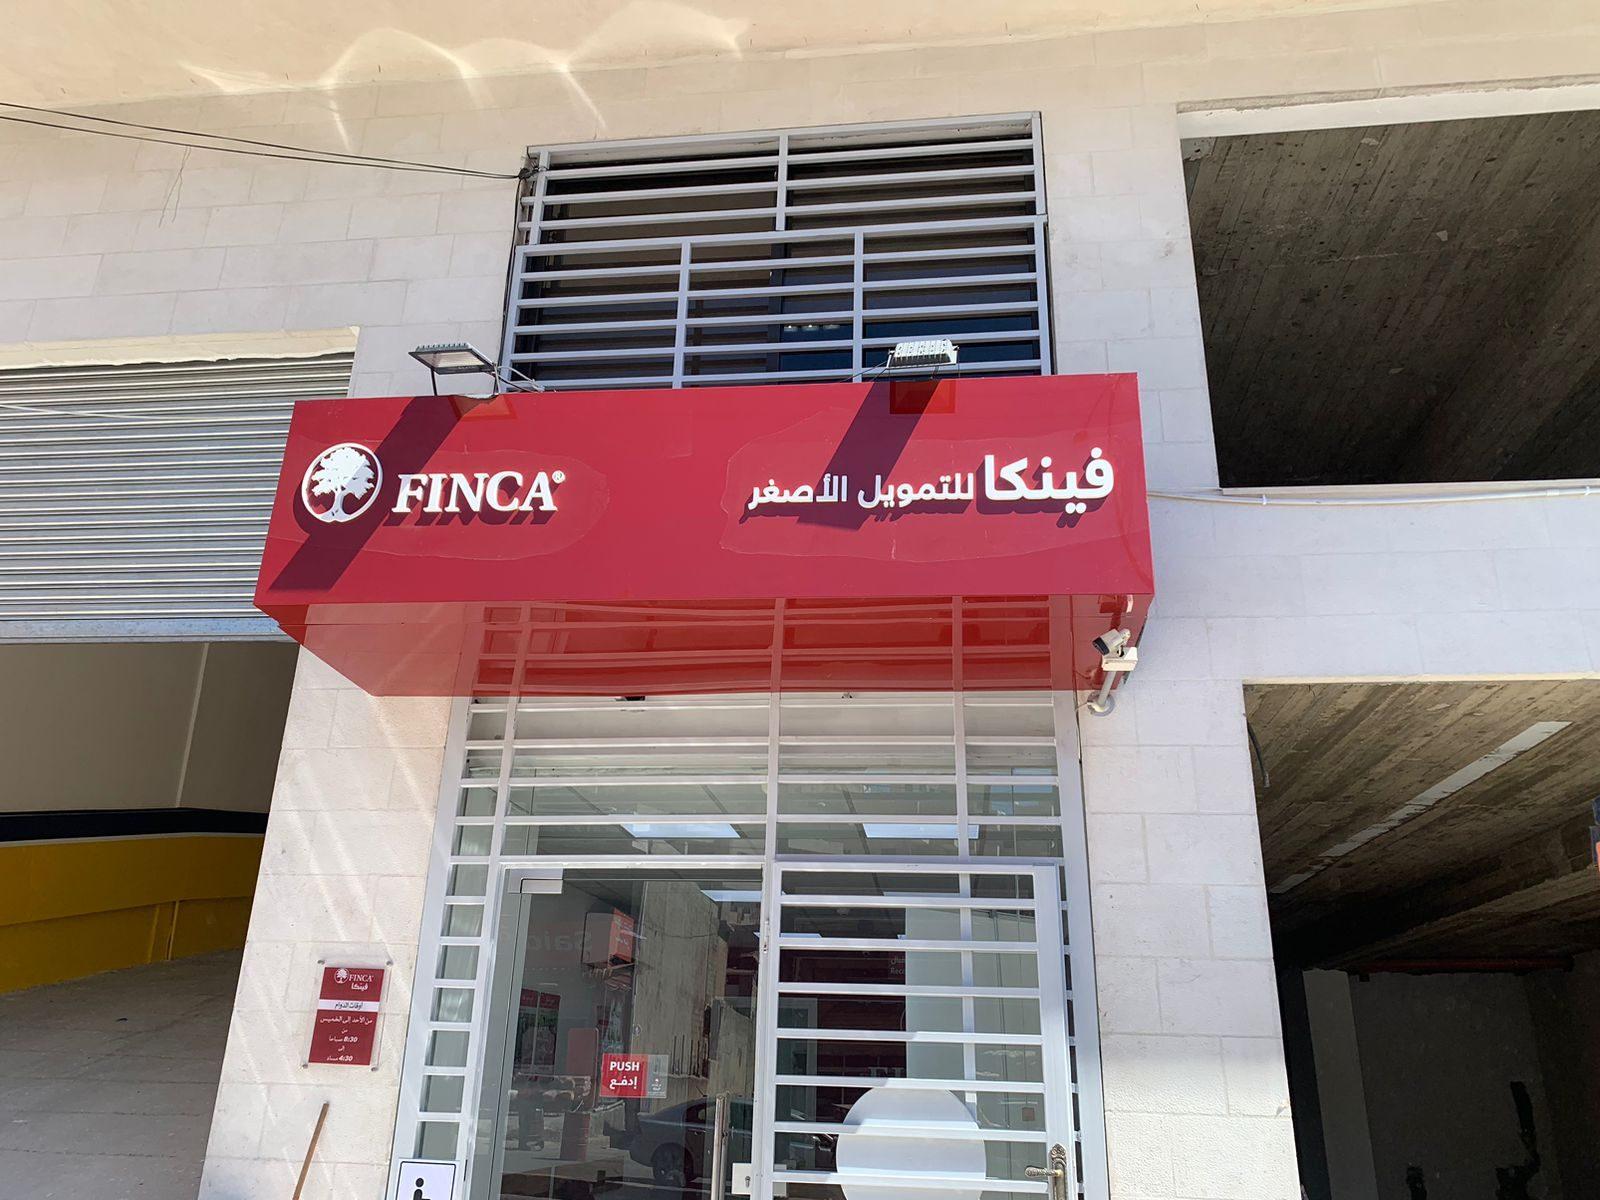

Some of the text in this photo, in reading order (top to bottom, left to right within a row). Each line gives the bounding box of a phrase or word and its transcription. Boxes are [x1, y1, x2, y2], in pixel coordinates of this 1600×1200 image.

[748, 447, 1115, 514] فينكا للتمويل الأصغر
[609, 1061, 640, 1071] PUSH
